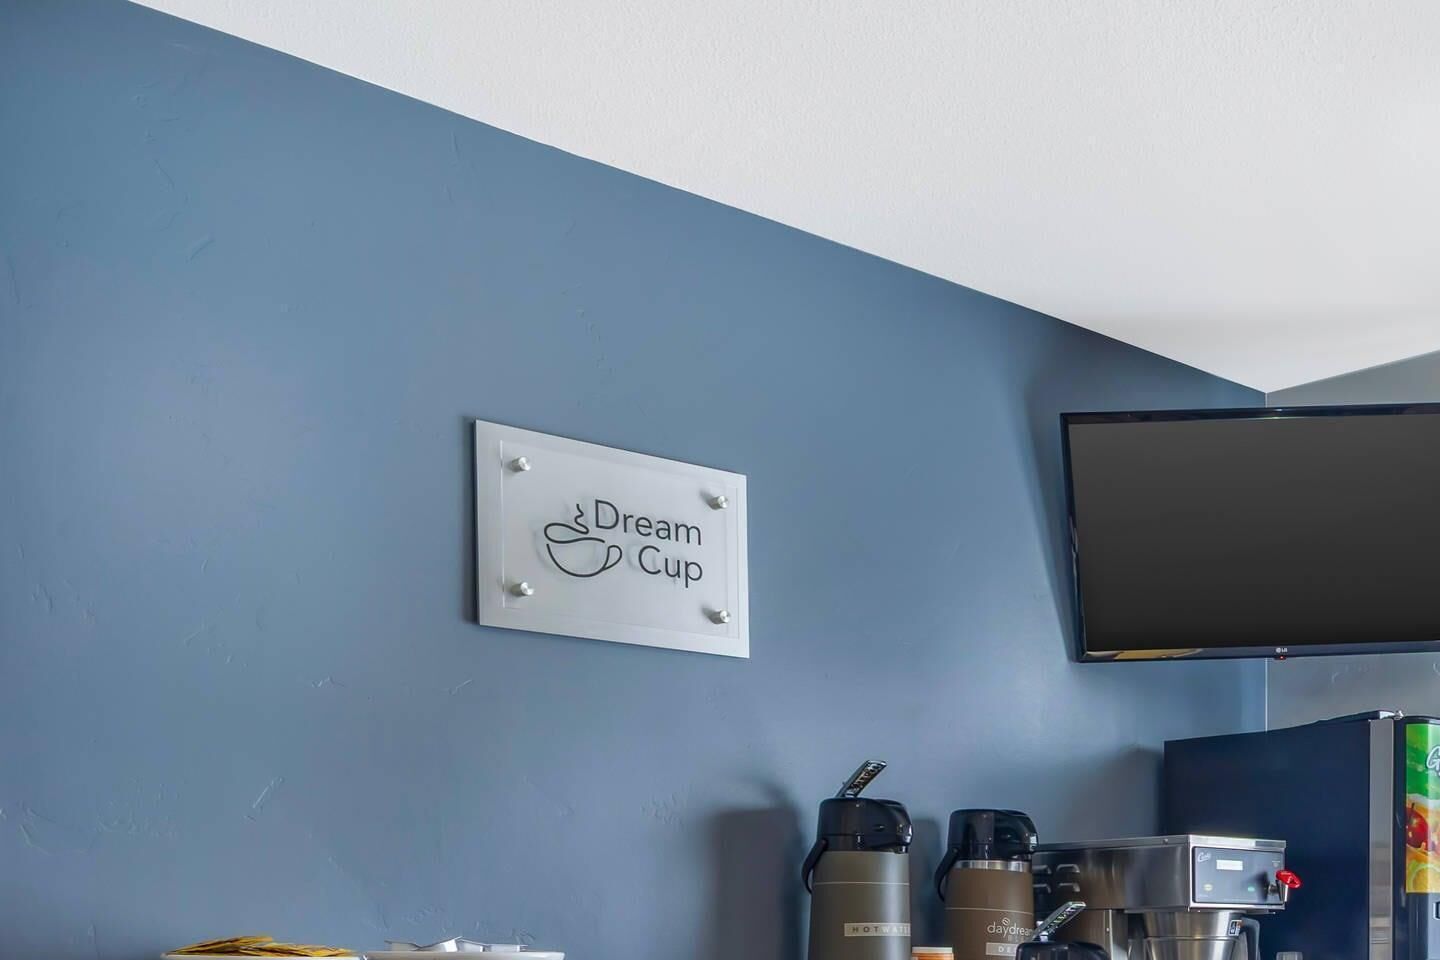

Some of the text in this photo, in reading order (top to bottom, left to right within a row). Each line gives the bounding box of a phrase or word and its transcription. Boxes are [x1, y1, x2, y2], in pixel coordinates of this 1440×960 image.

[594, 498, 702, 546] Dream
[638, 545, 703, 589] Cup
[851, 926, 879, 934] HOT
